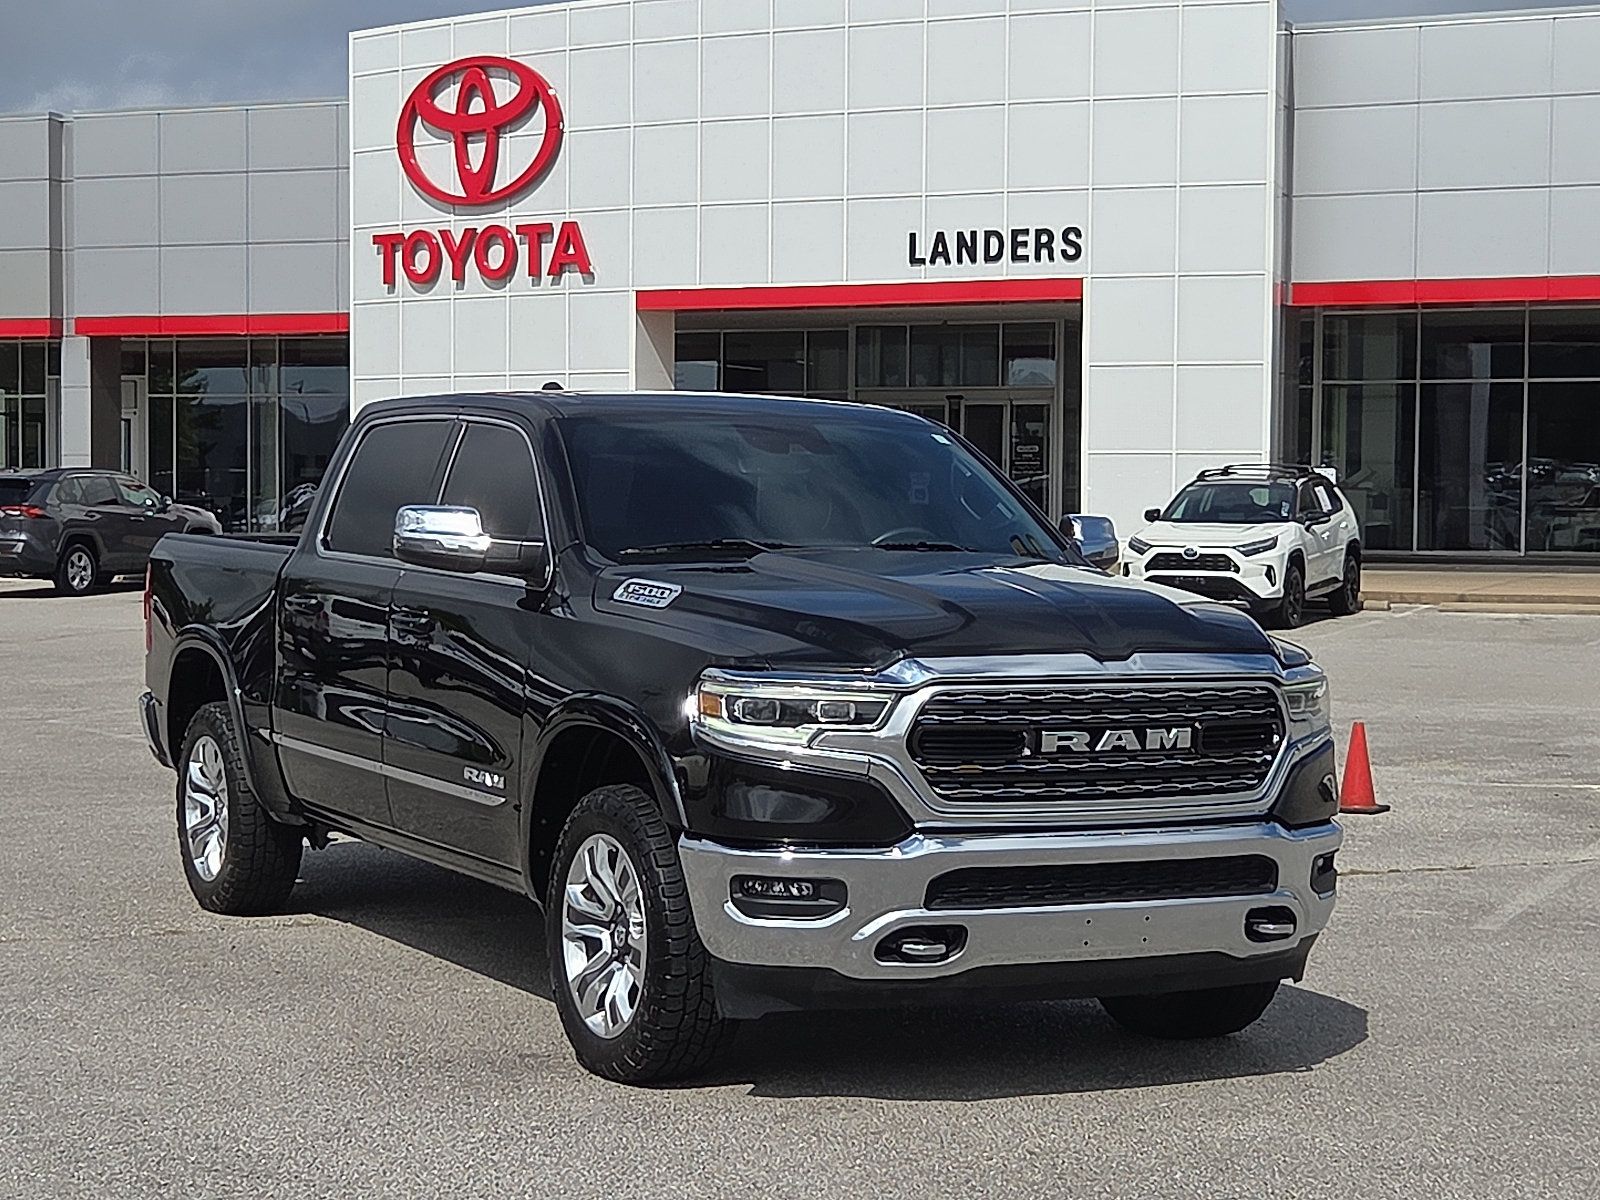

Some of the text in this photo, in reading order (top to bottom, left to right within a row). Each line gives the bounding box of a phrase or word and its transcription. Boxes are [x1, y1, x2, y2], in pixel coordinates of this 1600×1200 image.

[372, 221, 593, 285] TOYOTA
[908, 226, 1083, 266] LANDERS
[627, 583, 672, 598] 1500
[1040, 727, 1192, 752] RAM
[463, 766, 505, 789] RAM
